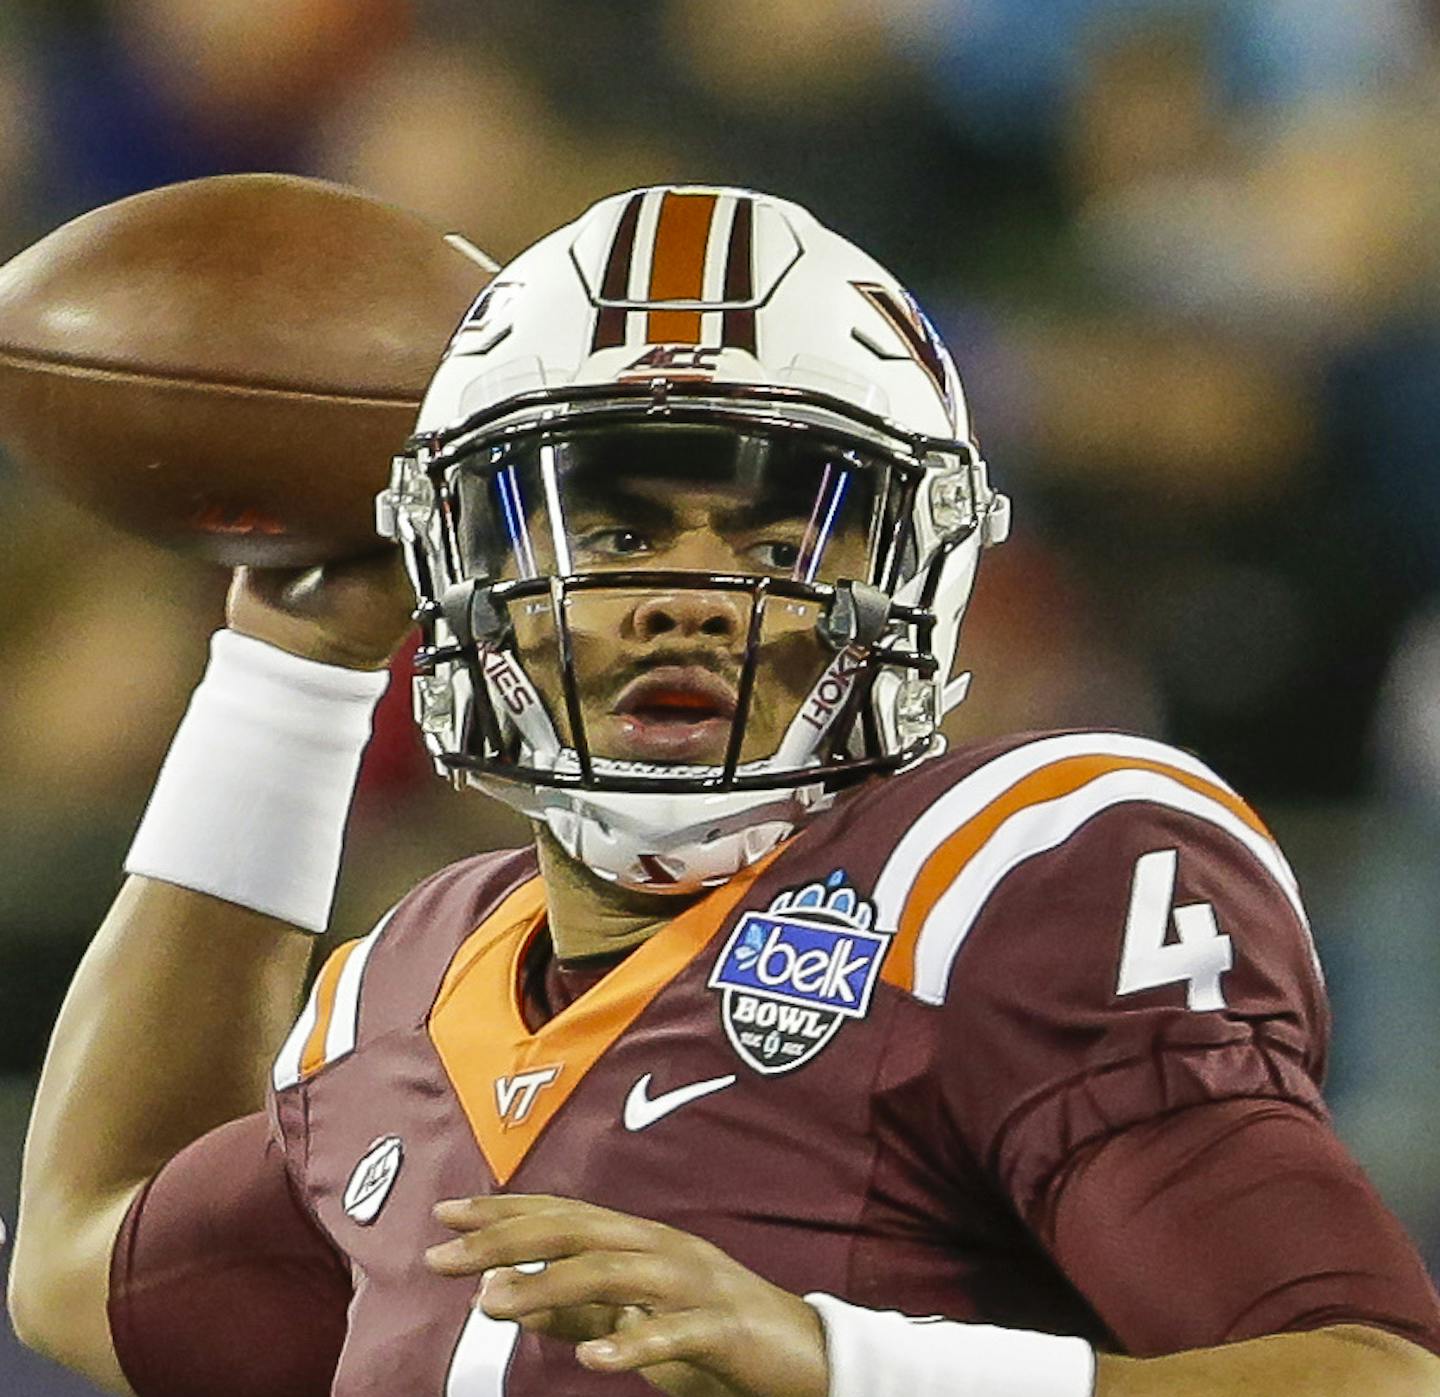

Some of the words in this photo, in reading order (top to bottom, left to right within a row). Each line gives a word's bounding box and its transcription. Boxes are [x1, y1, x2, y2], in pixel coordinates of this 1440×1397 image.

[1116, 849, 1232, 1011] 4
[757, 926, 869, 1003] belk
[733, 996, 829, 1039] BOWL
[494, 1067, 558, 1120] VT
